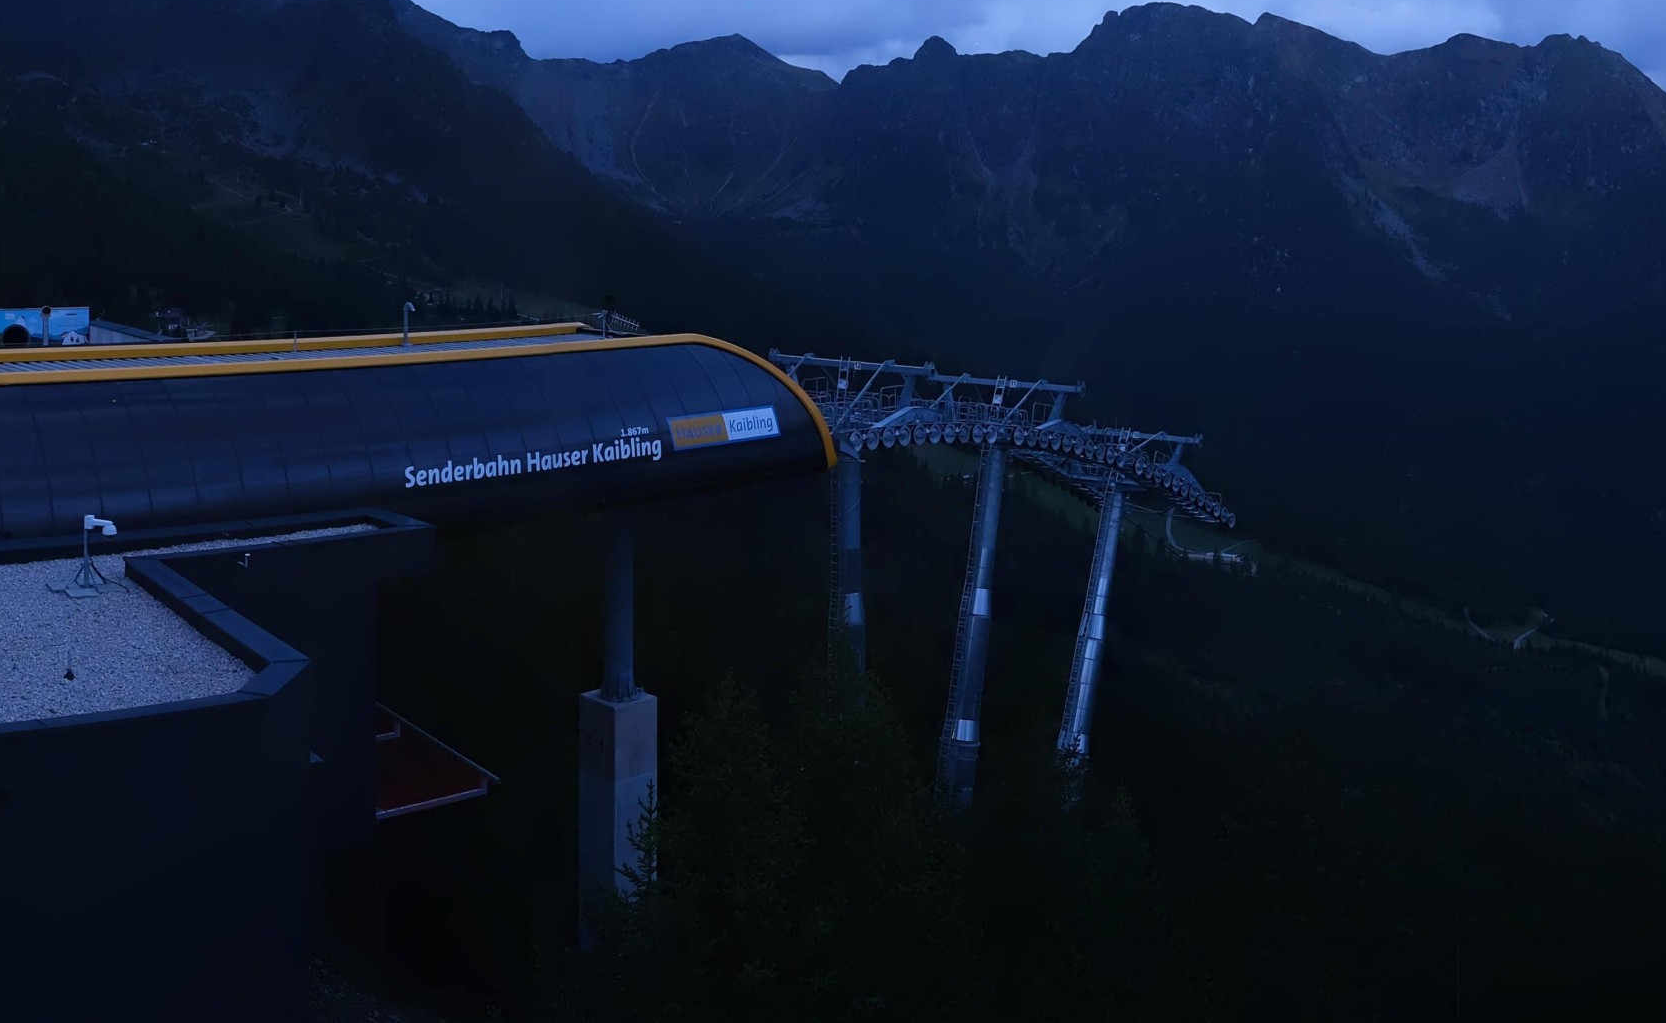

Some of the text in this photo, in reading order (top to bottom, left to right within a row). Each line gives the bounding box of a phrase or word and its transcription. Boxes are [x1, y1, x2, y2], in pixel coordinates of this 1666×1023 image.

[620, 426, 649, 438] 1.867m
[729, 415, 774, 434] Kaibling
[404, 437, 663, 489] Senderbahn Hauser Kaibling
